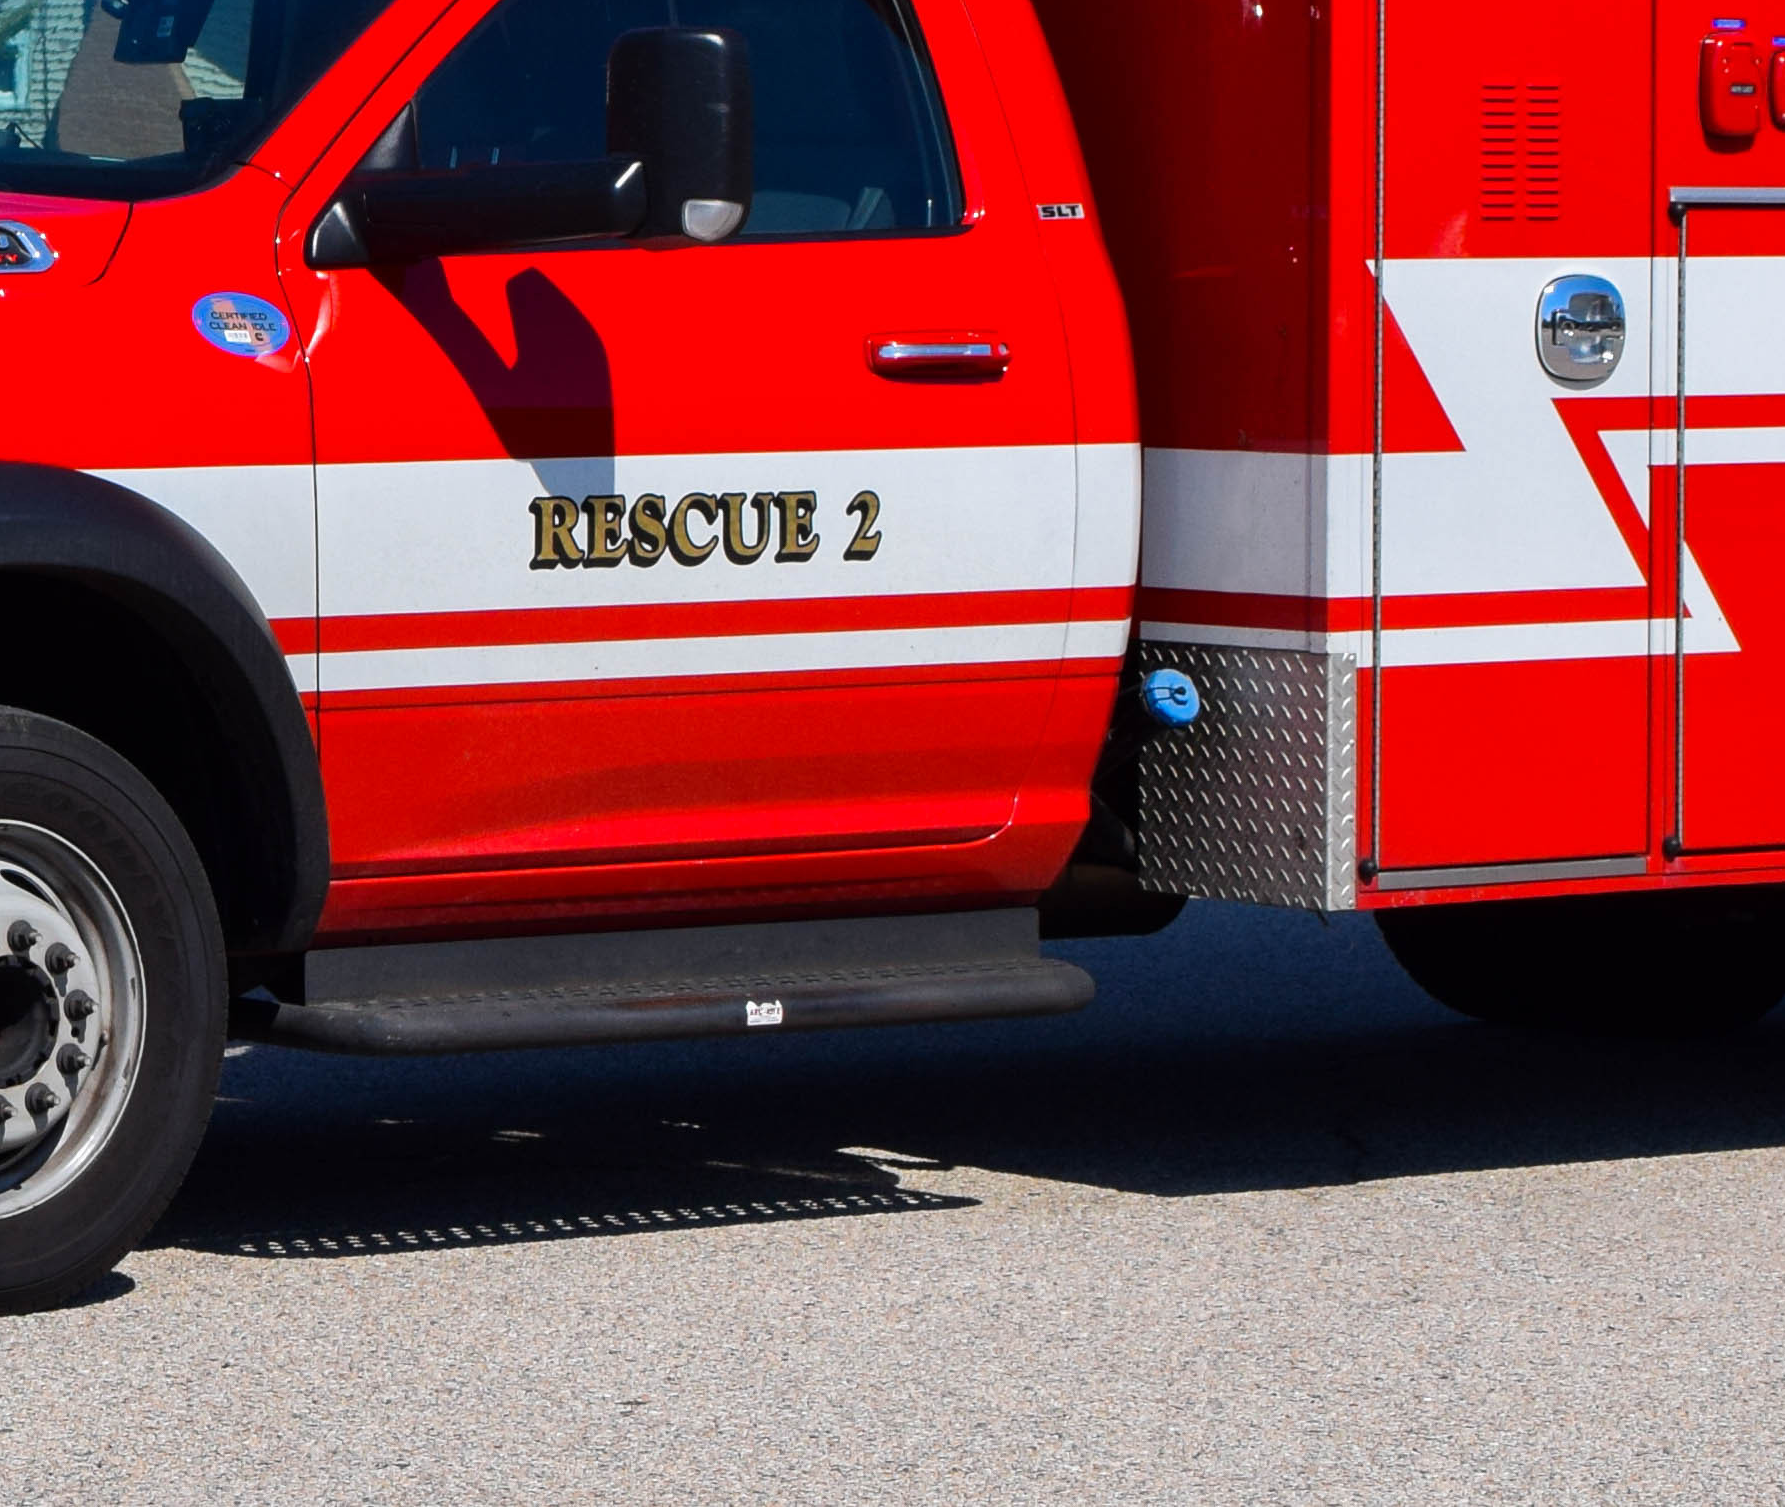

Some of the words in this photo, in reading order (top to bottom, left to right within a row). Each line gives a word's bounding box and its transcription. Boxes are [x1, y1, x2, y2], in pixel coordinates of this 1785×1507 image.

[1042, 204, 1079, 218] SLT
[210, 311, 268, 321] CERTIFIED
[209, 321, 247, 331] CLEAN
[251, 322, 276, 331] IDLE
[529, 491, 820, 569] RESCUE
[843, 490, 883, 561] 2
